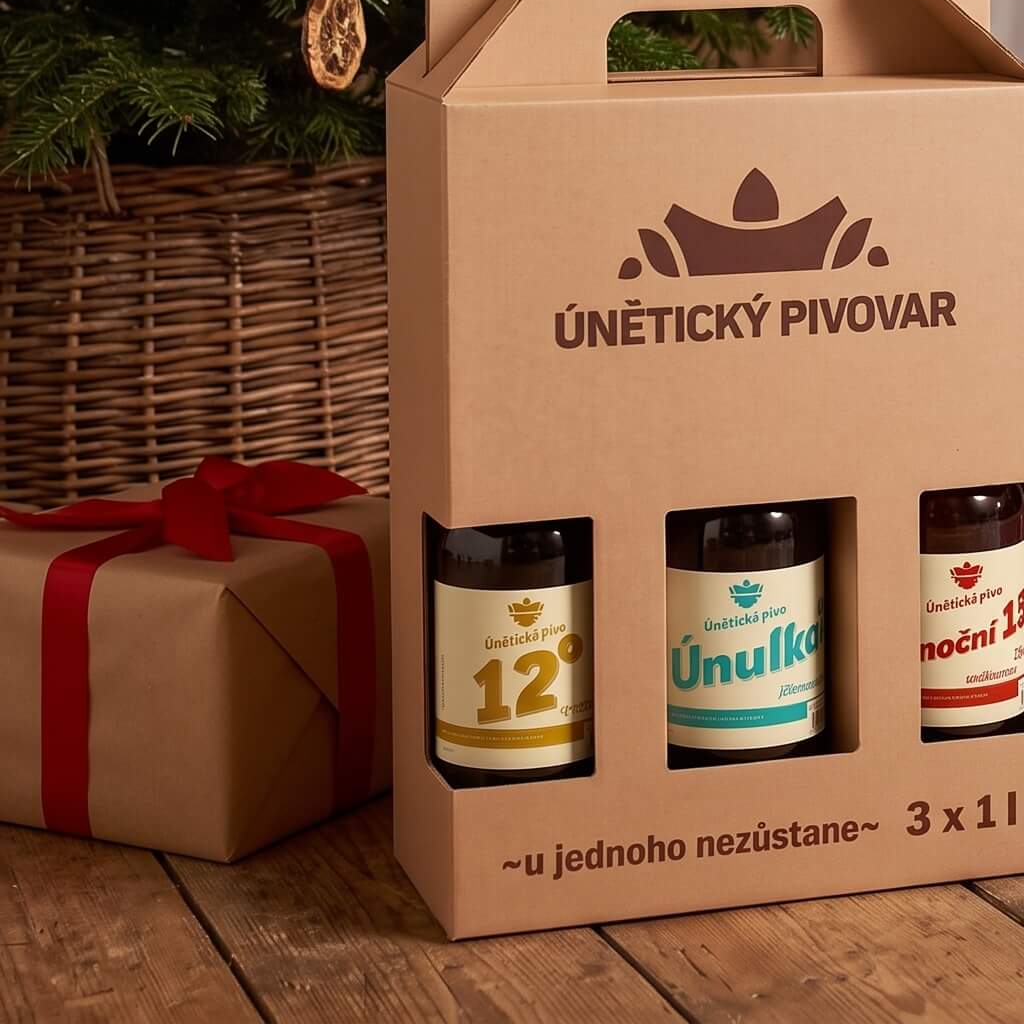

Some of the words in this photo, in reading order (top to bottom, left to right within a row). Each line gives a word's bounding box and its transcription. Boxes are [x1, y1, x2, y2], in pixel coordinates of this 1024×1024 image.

[554, 293, 771, 349] ÚNĚTICKÝ
[780, 291, 957, 336] PIVOVAR
[979, 586, 1003, 605] pivo
[761, 605, 787, 624] pivo
[540, 623, 567, 642] pivo
[905, 800, 931, 837] 3
[942, 806, 966, 834] x
[976, 794, 997, 830] 1
[552, 834, 687, 881] jednoho
